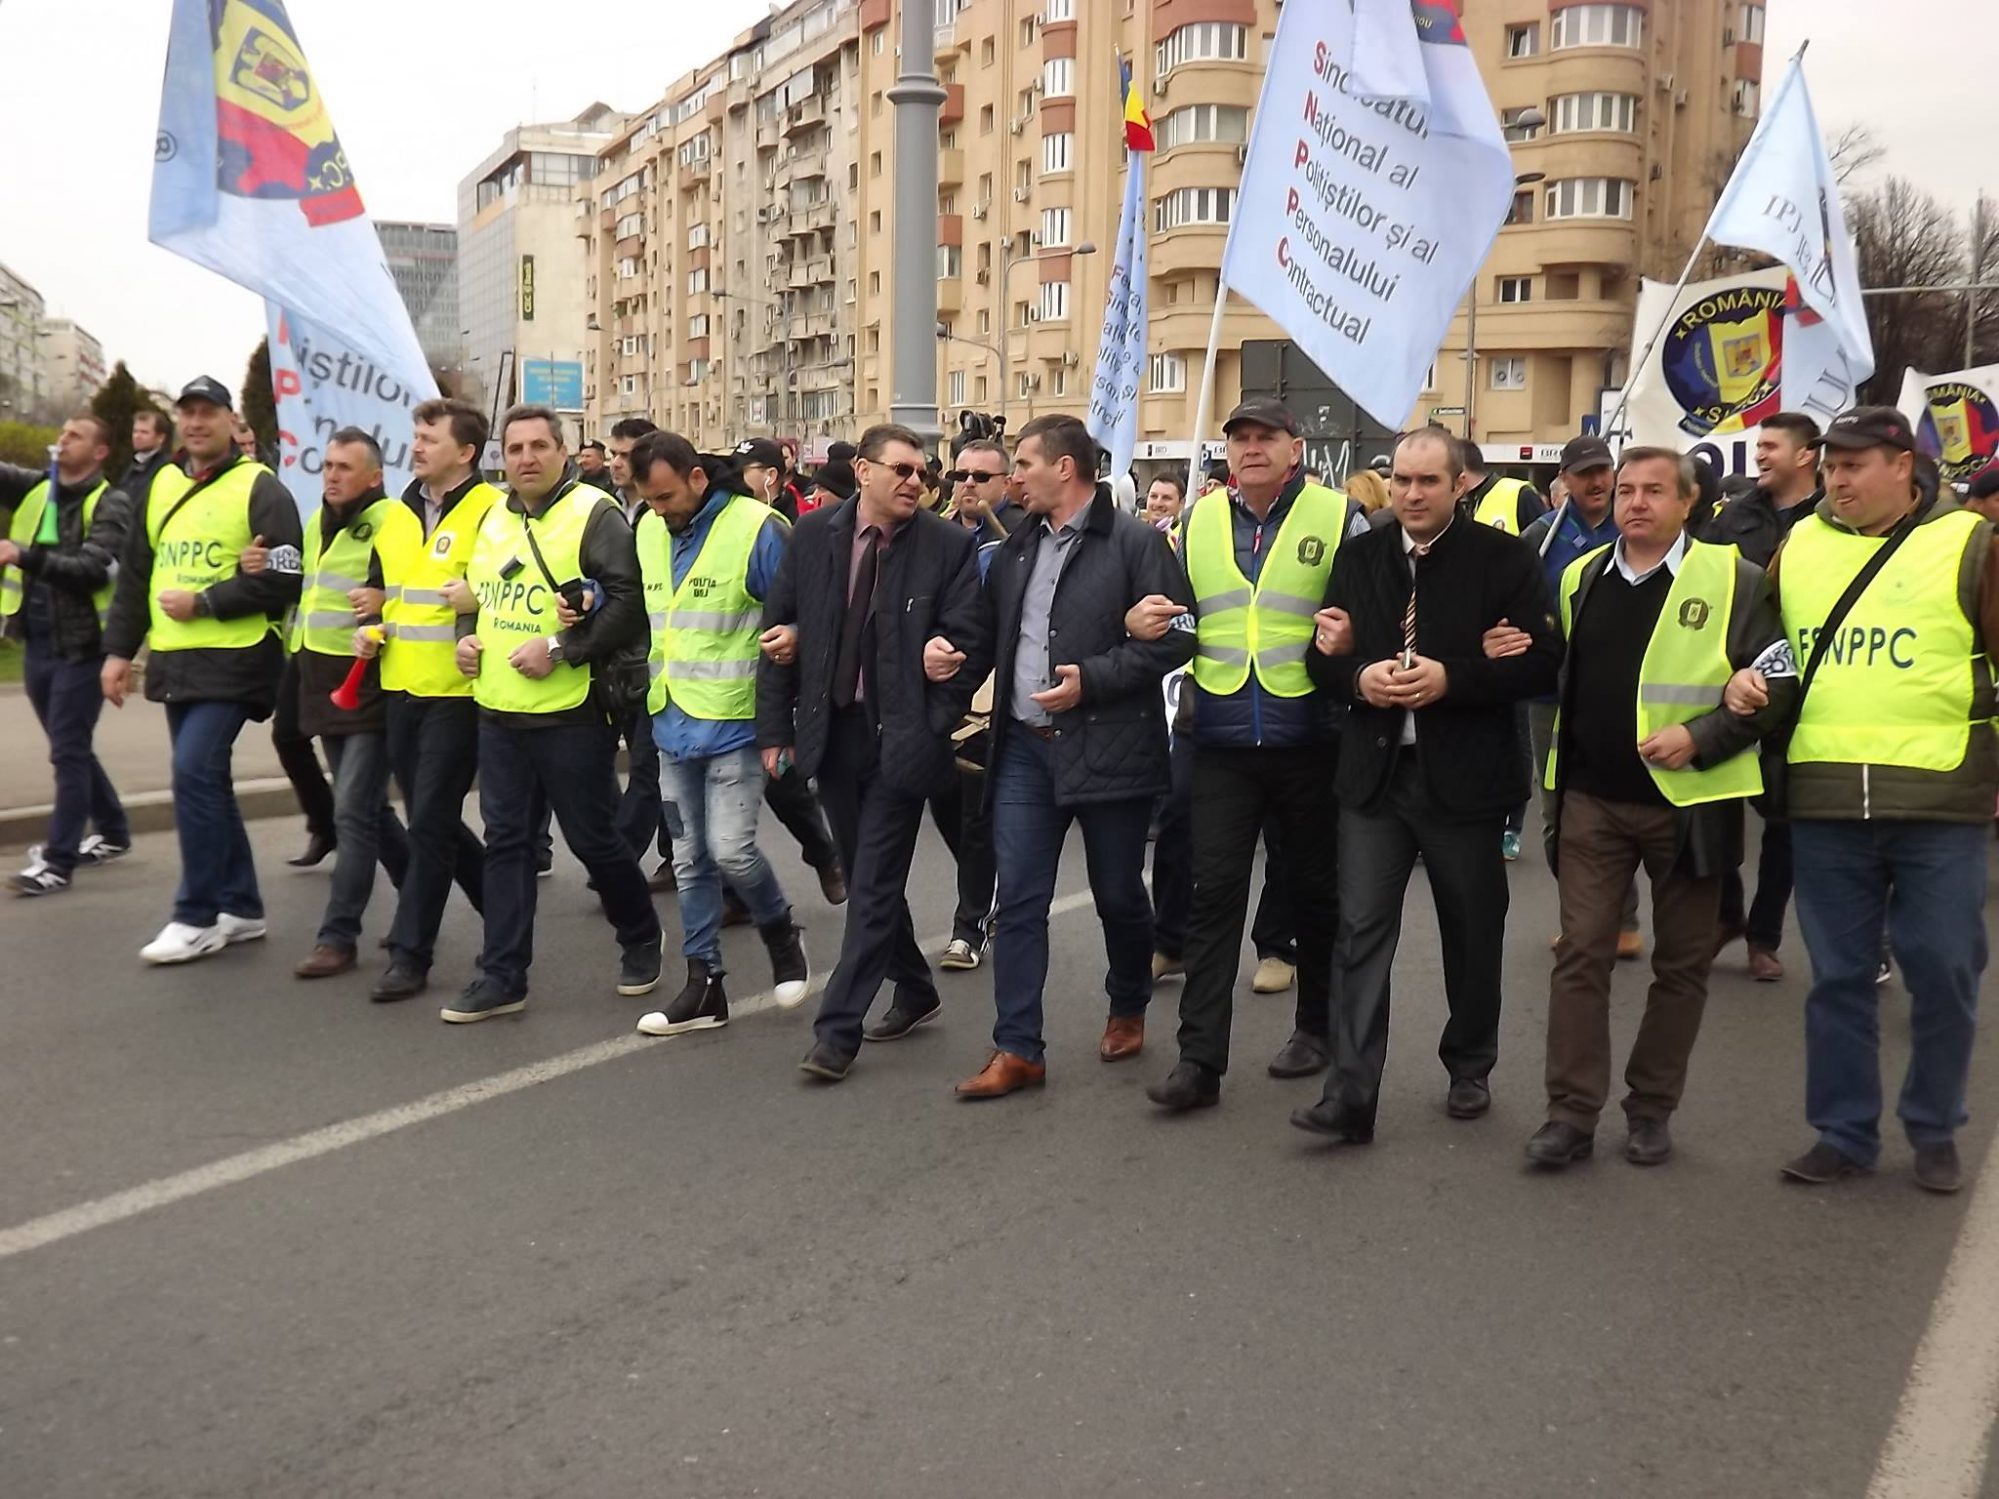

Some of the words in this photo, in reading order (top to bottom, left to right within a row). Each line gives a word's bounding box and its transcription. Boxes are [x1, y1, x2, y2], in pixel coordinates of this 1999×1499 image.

[1389, 164, 1419, 191] al
[1286, 186, 1401, 303] Personalului
[1411, 238, 1440, 266] al
[1277, 236, 1372, 345] Contractual
[494, 617, 542, 634] ROMANIA
